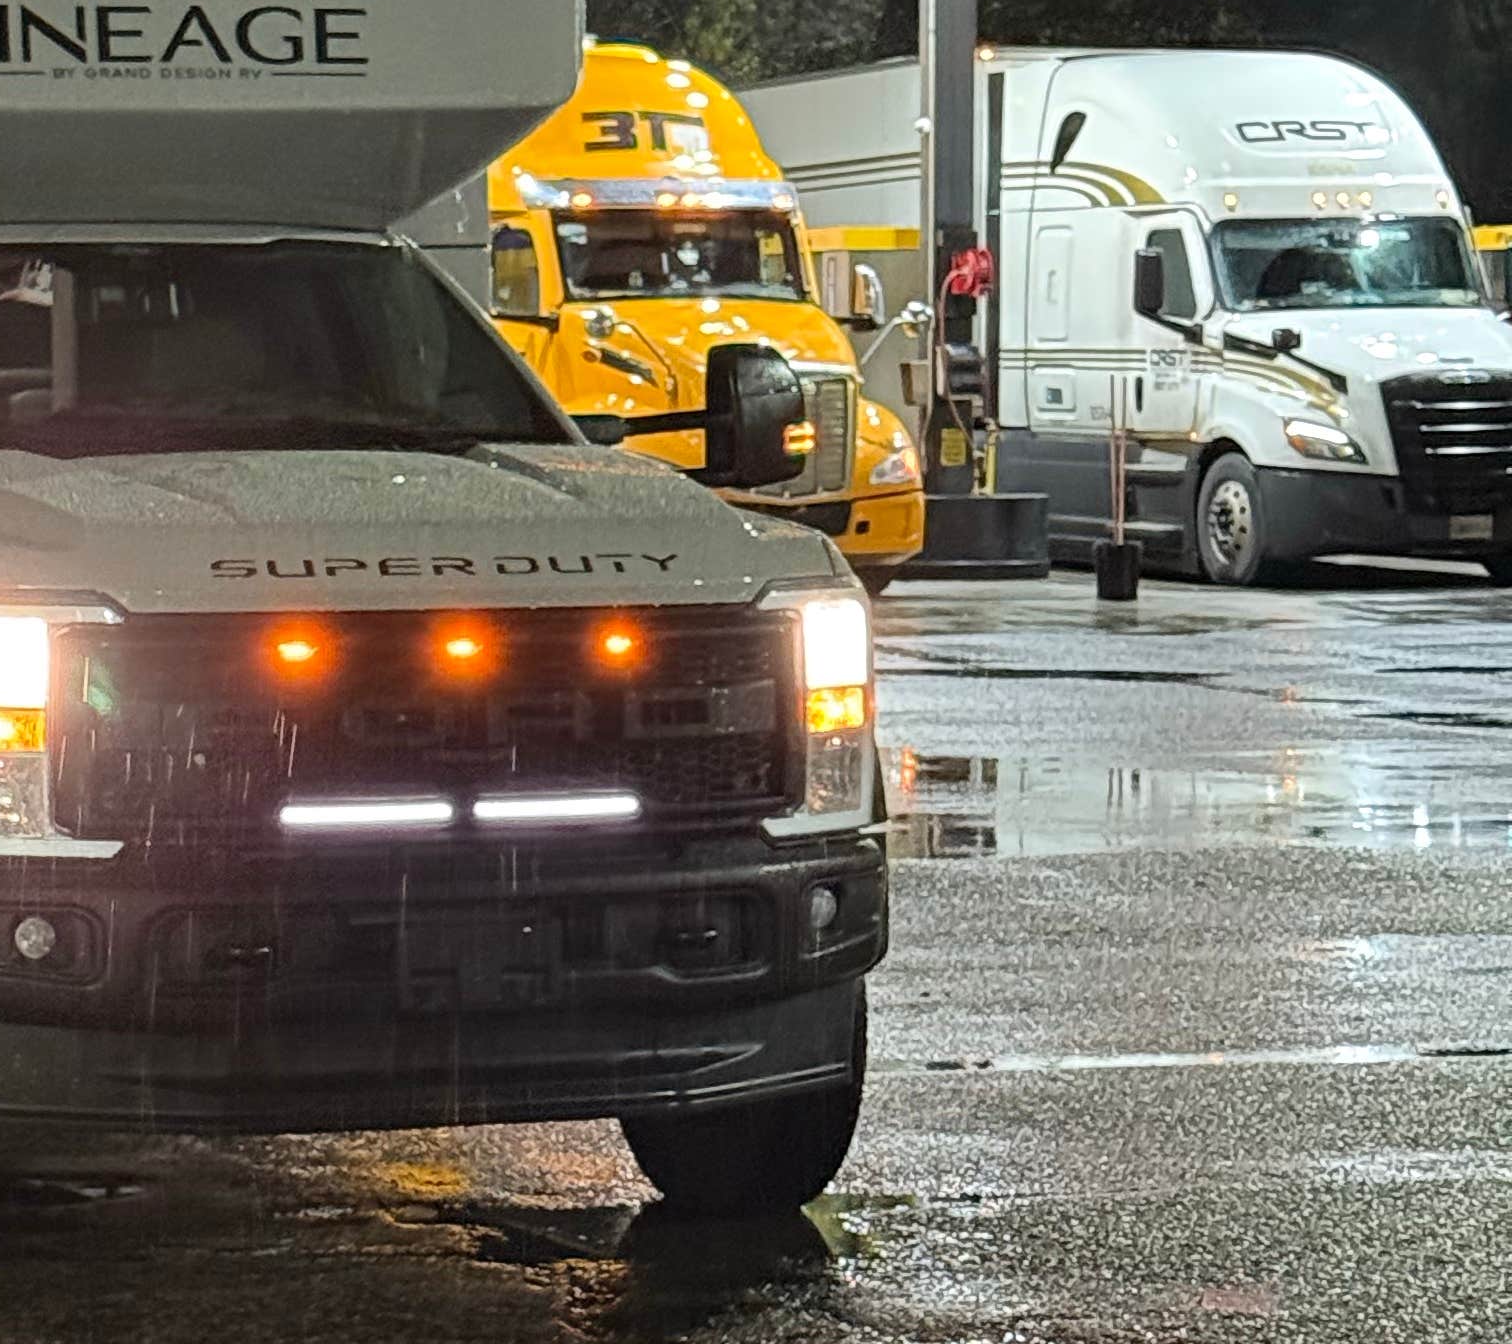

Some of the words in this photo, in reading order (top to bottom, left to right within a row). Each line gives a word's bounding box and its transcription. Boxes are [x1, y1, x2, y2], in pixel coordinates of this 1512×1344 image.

[52, 67, 75, 80] BY
[84, 67, 152, 80] GRAND
[160, 68, 232, 81] DESIGN
[239, 68, 263, 81] RV
[1235, 120, 1377, 144] CRST
[209, 556, 477, 579] SUPER
[492, 553, 679, 576] DUTY
